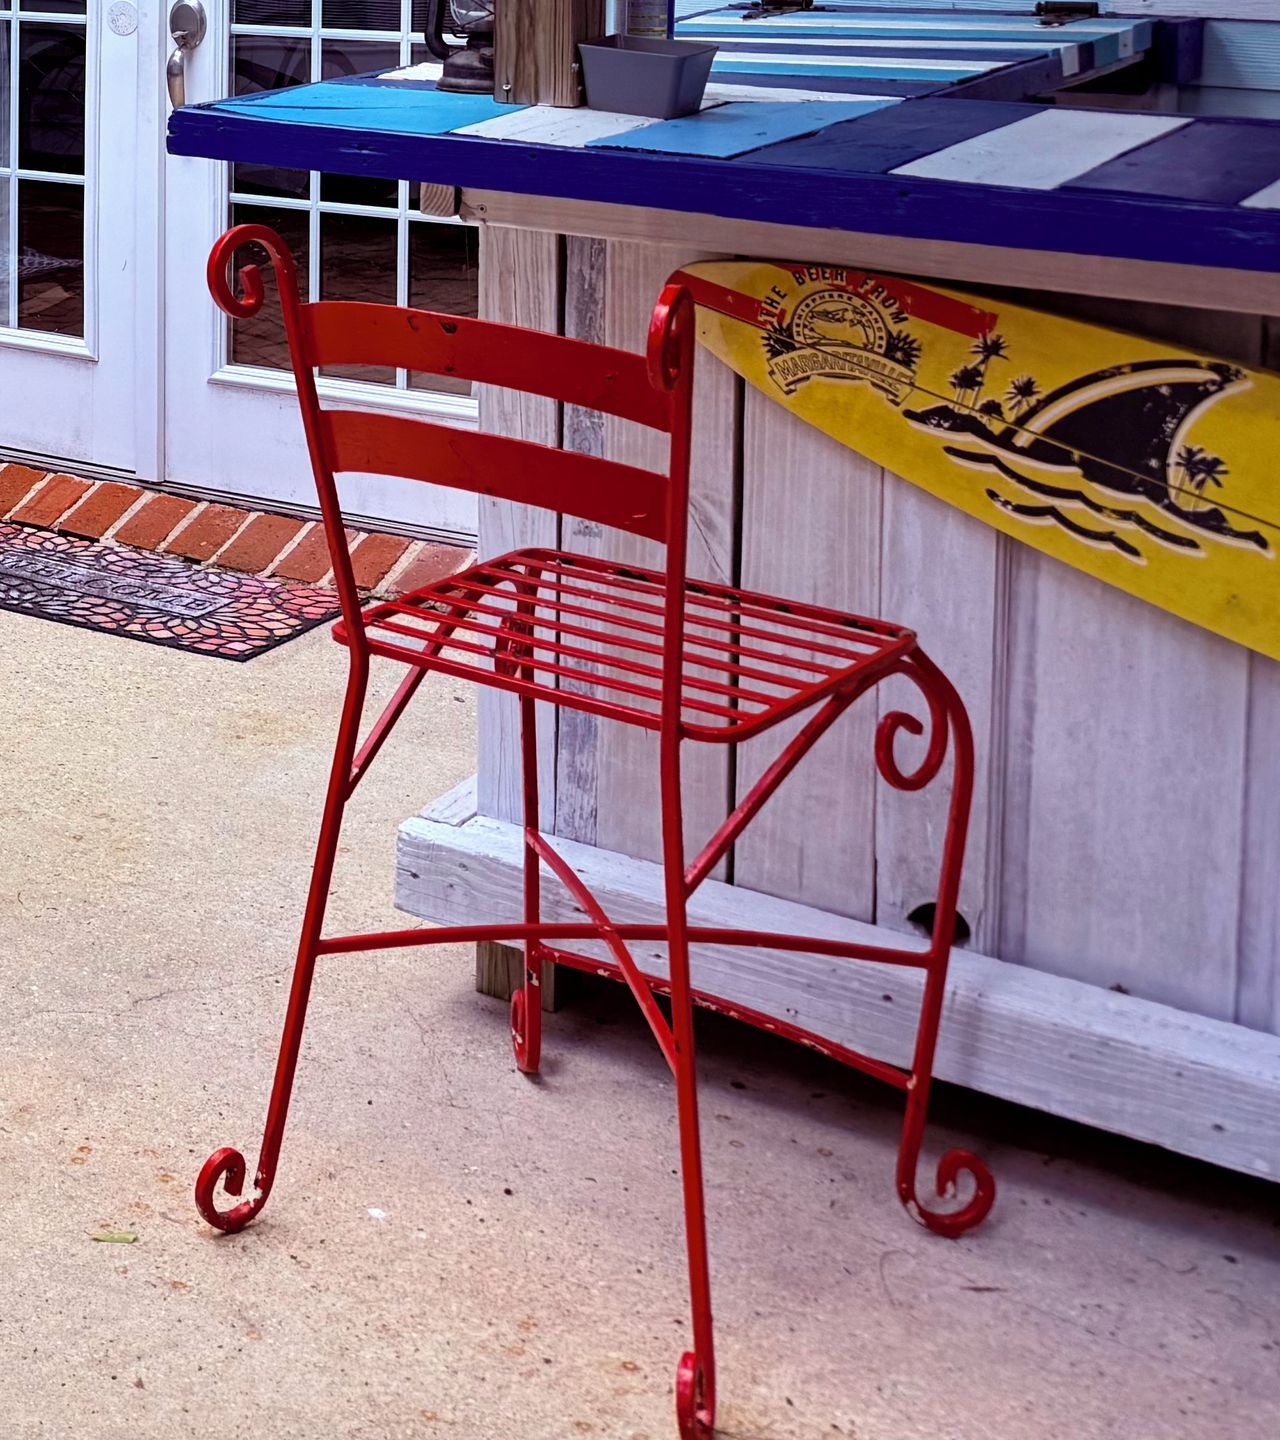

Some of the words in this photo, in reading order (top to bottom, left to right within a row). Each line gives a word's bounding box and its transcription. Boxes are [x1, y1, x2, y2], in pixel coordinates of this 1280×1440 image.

[758, 285, 788, 323] THE
[792, 267, 847, 286] BEER
[859, 276, 909, 325] FROM
[795, 292, 853, 337] HEMISPHERE
[860, 302, 884, 350] DANCER
